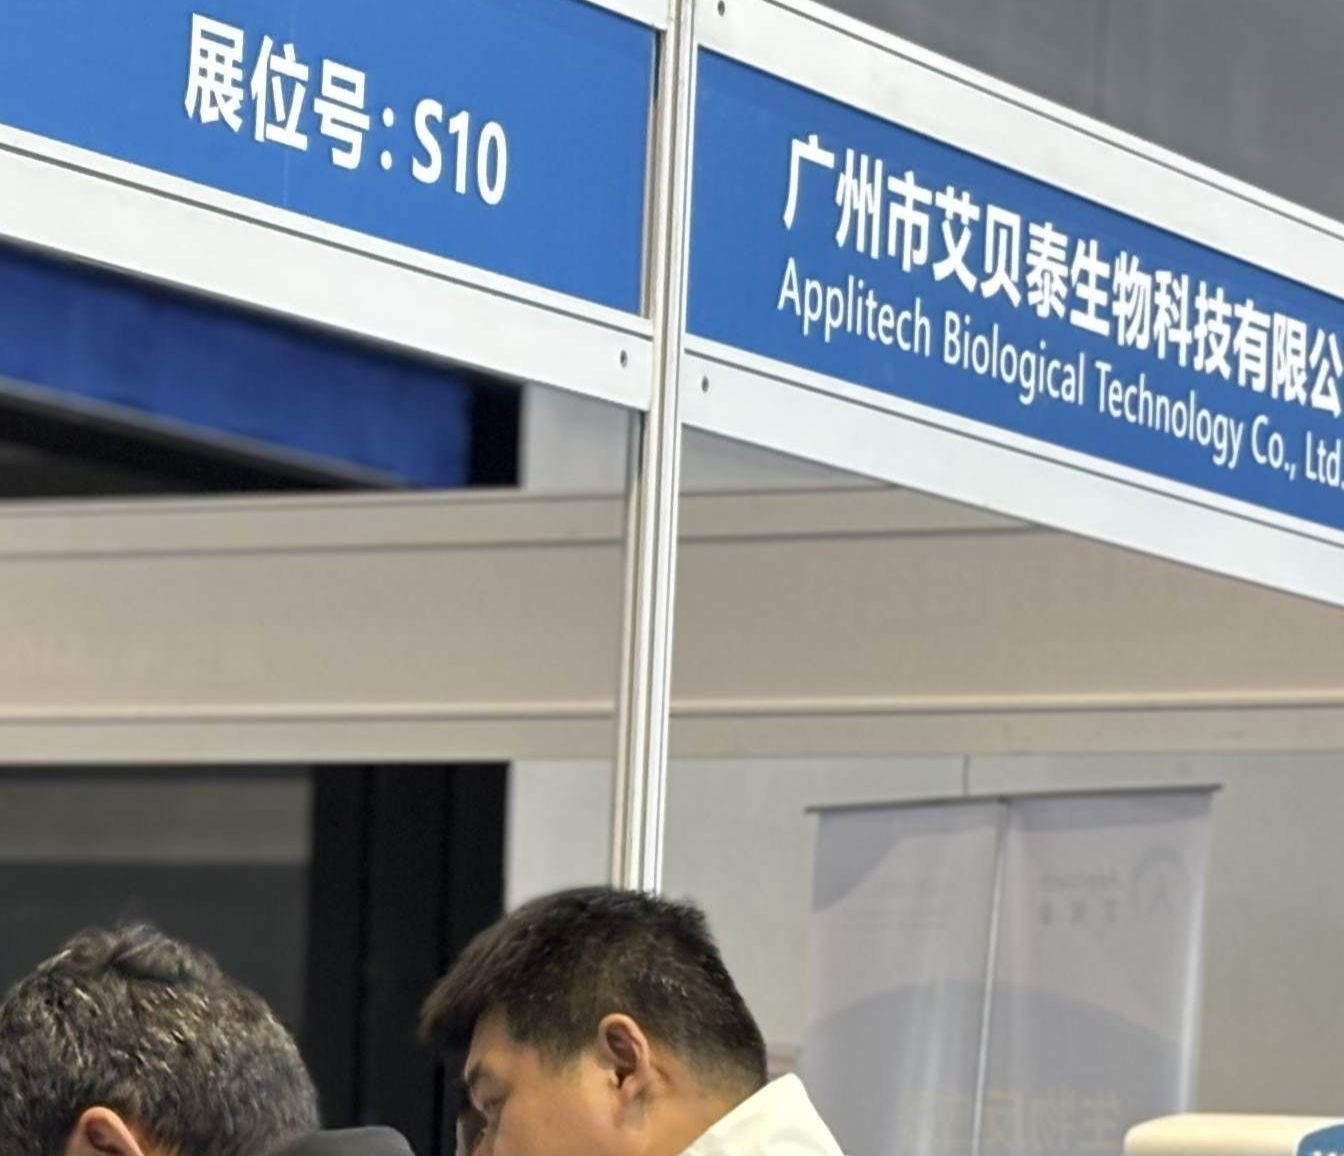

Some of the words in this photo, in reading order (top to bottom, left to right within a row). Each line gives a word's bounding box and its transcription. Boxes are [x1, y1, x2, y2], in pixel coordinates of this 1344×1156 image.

[777, 257, 932, 357] Applitech
[943, 309, 1086, 405] Biological
[1094, 359, 1244, 469] Technology
[1251, 414, 1297, 480] Co.,
